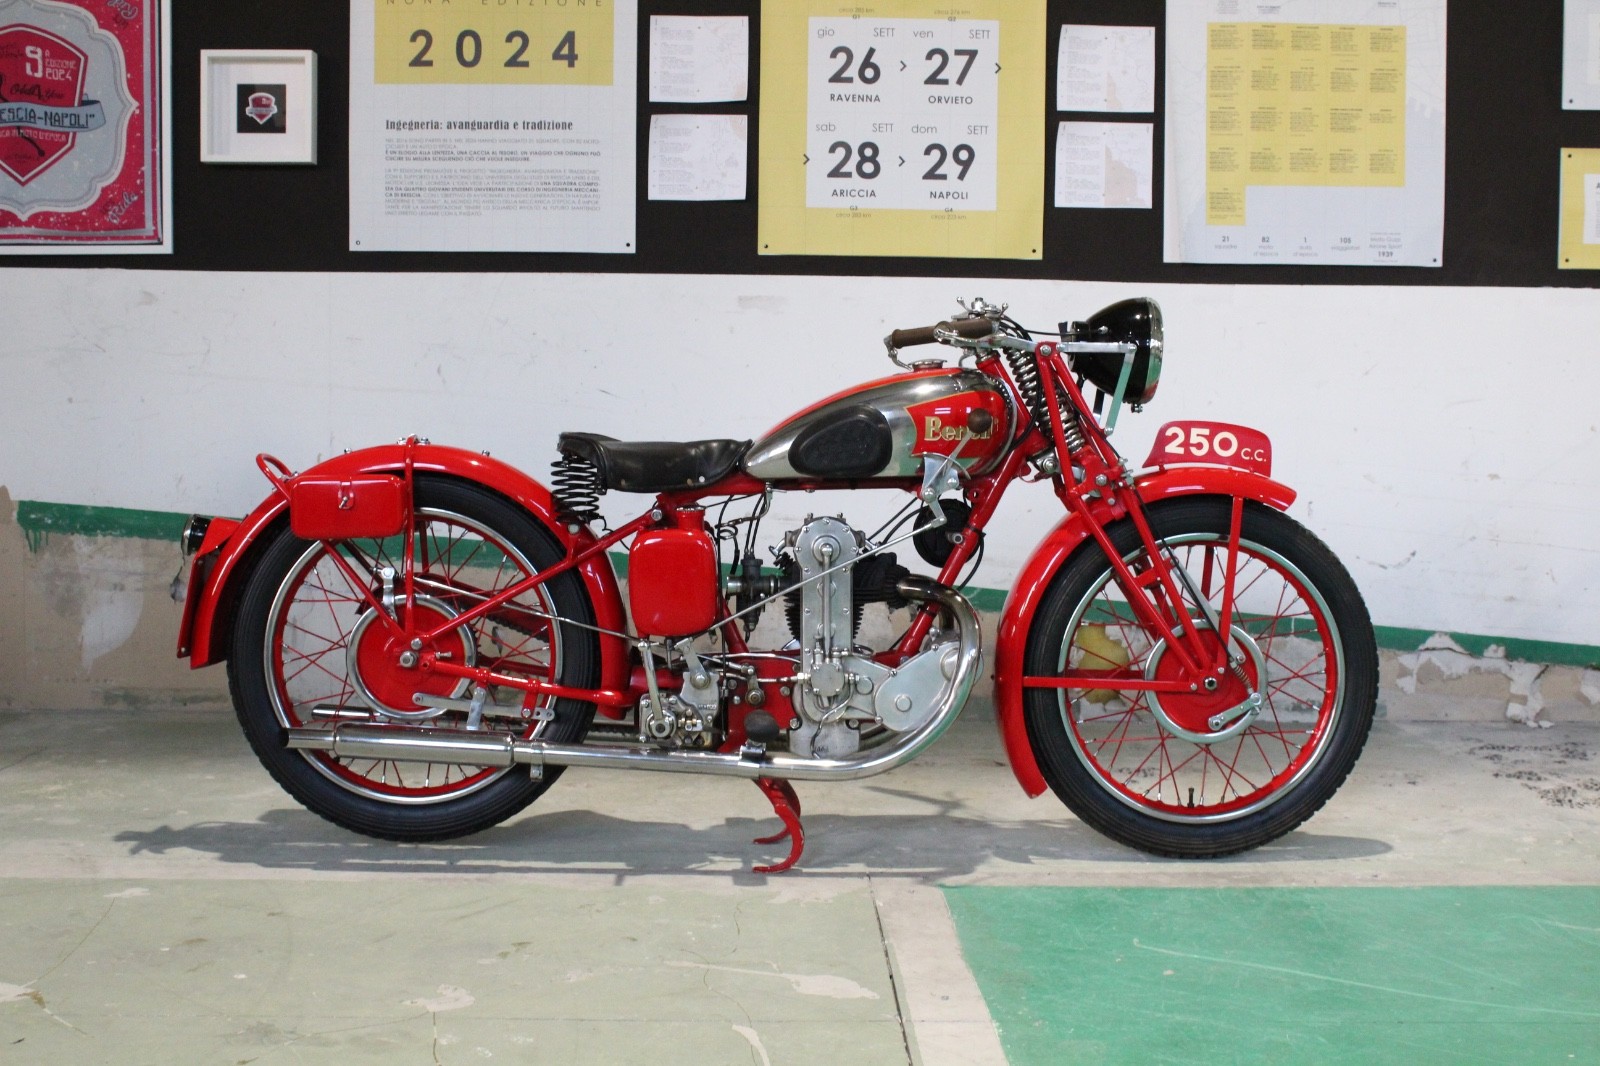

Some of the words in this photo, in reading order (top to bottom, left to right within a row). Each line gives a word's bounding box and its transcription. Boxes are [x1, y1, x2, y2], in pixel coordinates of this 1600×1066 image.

[817, 27, 835, 39] gio
[873, 28, 896, 37] SETT
[913, 30, 934, 38] ven
[969, 30, 990, 39] SETT
[408, 29, 578, 68] 2024
[828, 46, 881, 84] 26
[923, 48, 978, 86] 27
[830, 93, 881, 103] RAVENNA
[928, 95, 973, 105] ORVIETO
[385, 120, 443, 131] Ingegneria:
[446, 120, 510, 131] avanguardia
[522, 120, 573, 130] tradizione
[815, 122, 836, 132] sab
[872, 123, 894, 133] SETT
[911, 124, 937, 134] dom
[967, 125, 988, 135] SETT
[827, 140, 881, 179] 28
[922, 143, 976, 181] 29
[831, 189, 876, 198] ARICCIA
[930, 191, 969, 200] NAPOLI
[1164, 426, 1238, 457] 250
